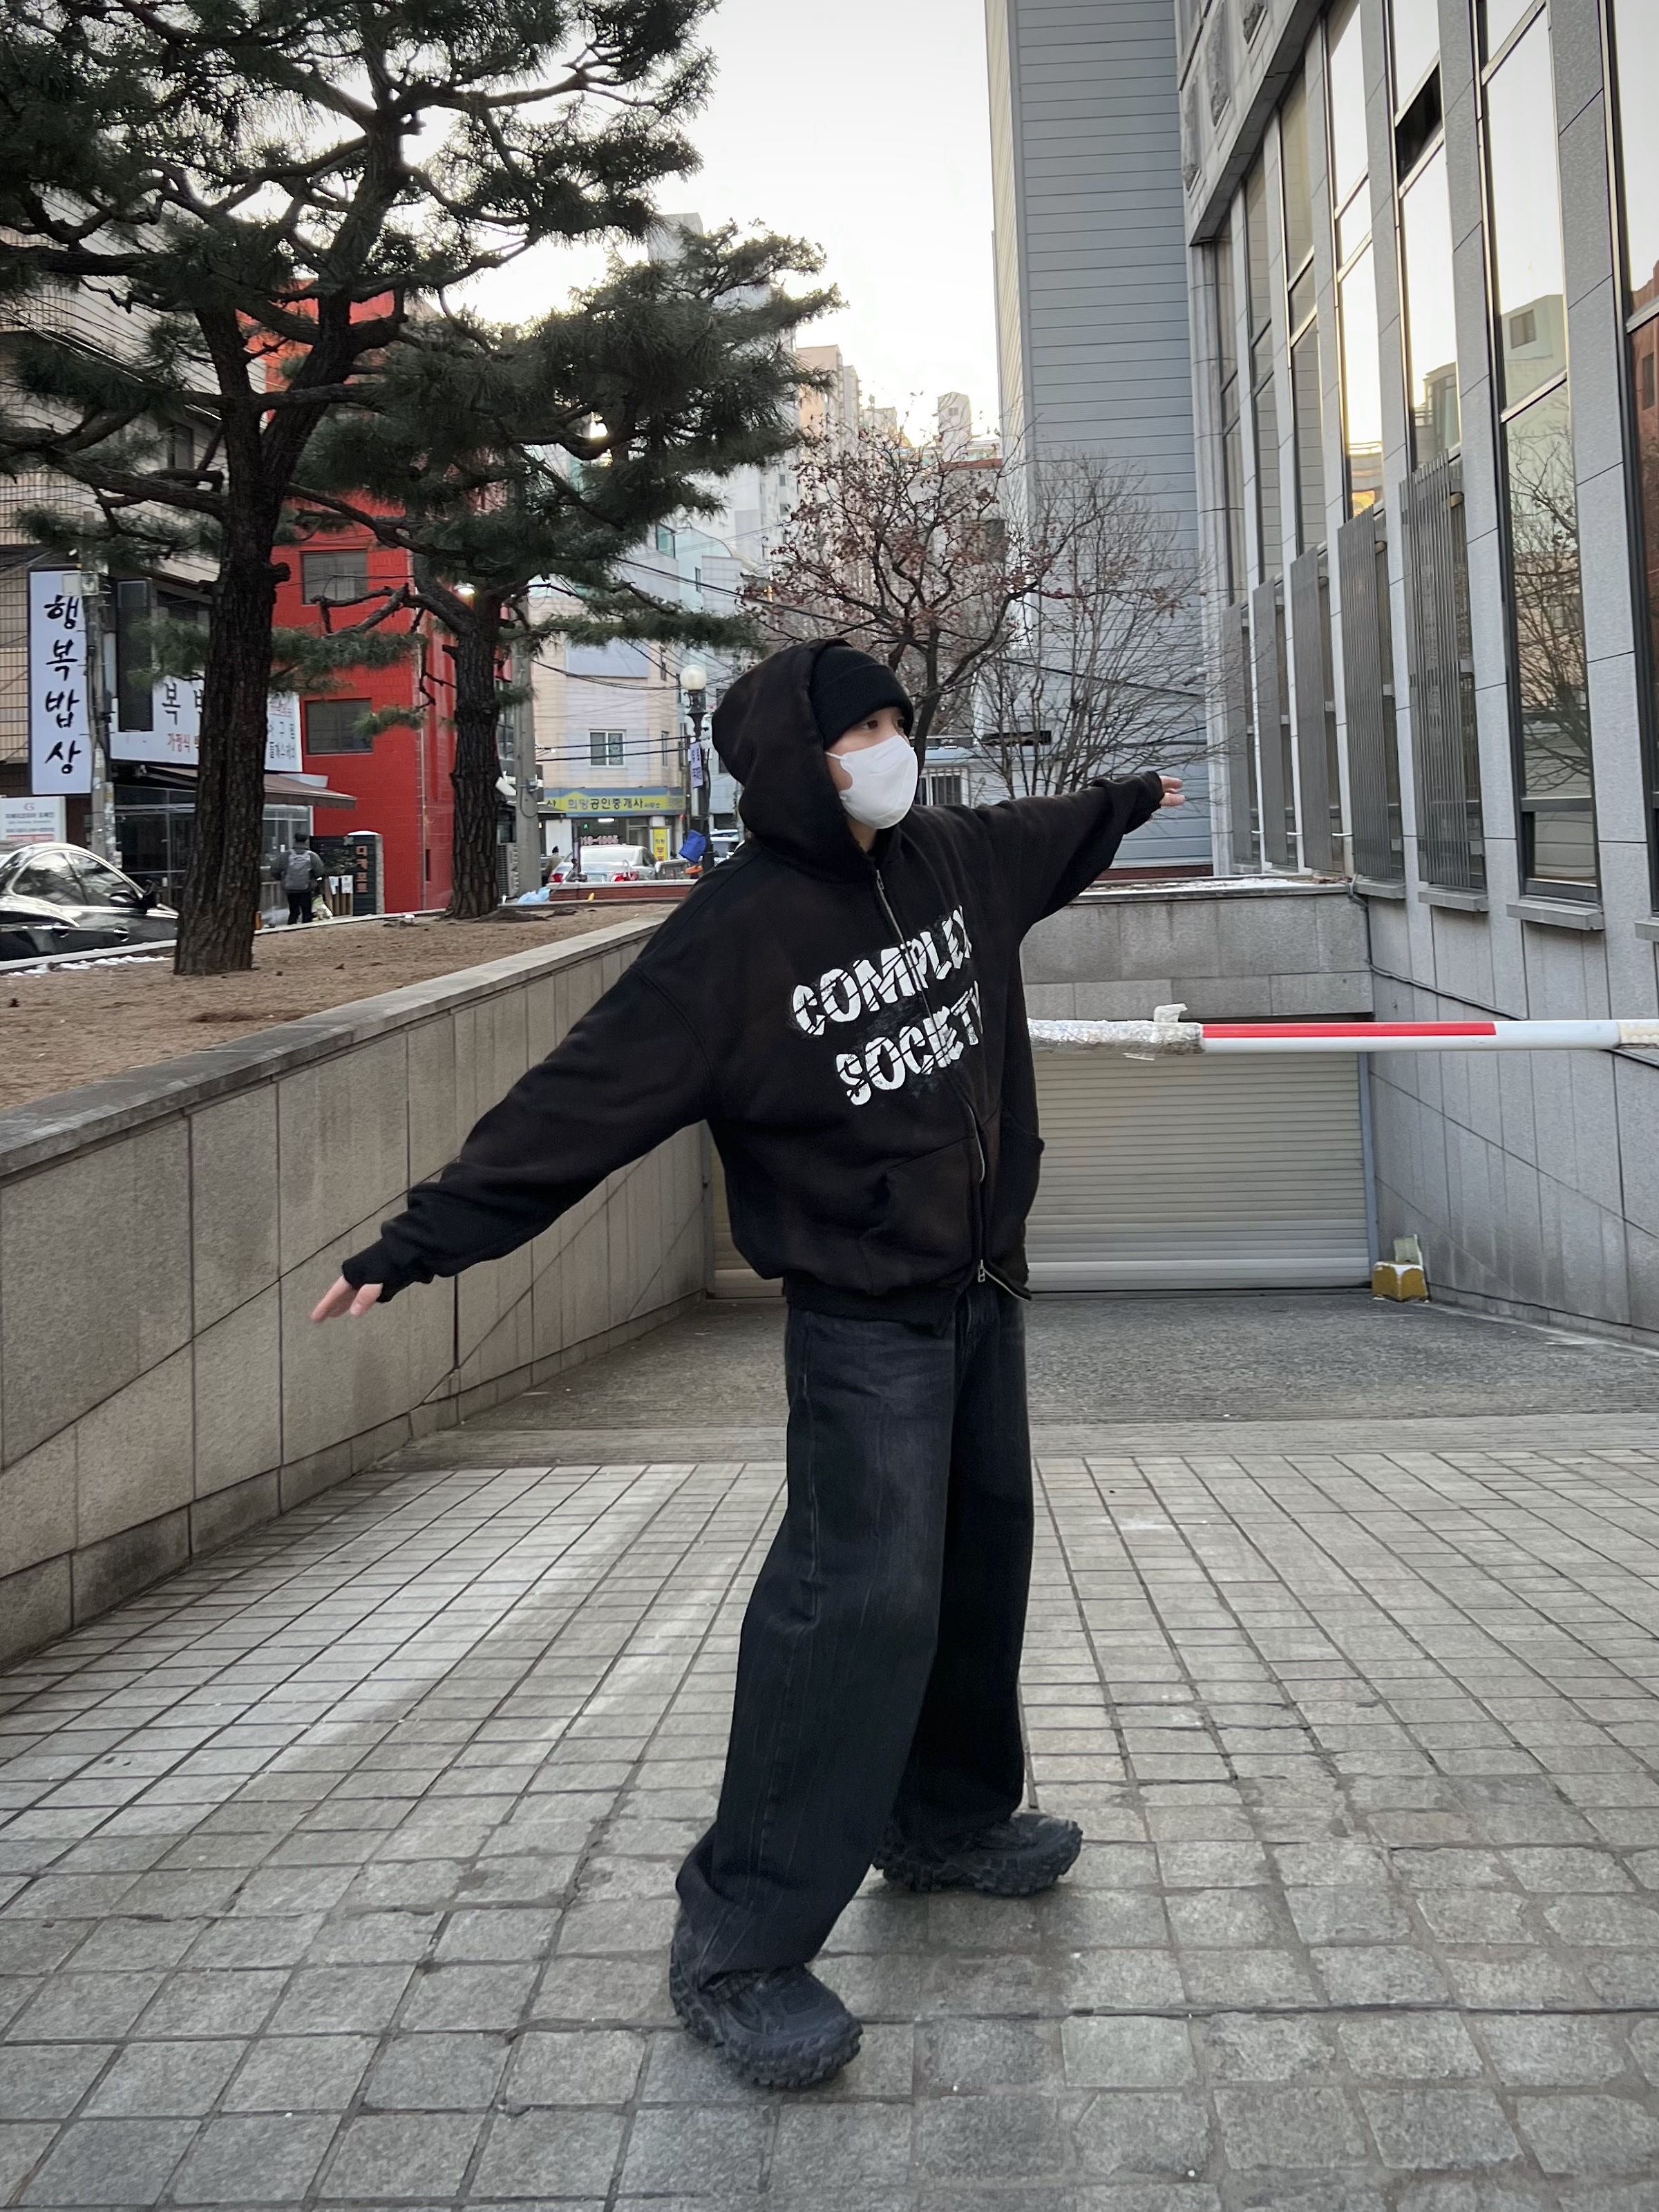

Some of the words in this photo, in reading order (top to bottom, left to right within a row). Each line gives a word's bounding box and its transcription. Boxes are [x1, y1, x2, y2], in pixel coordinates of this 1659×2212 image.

[44, 595, 82, 774] 행복밥상
[792, 904, 972, 1036] COMPLEX
[835, 980, 984, 1106] SOCIETY
